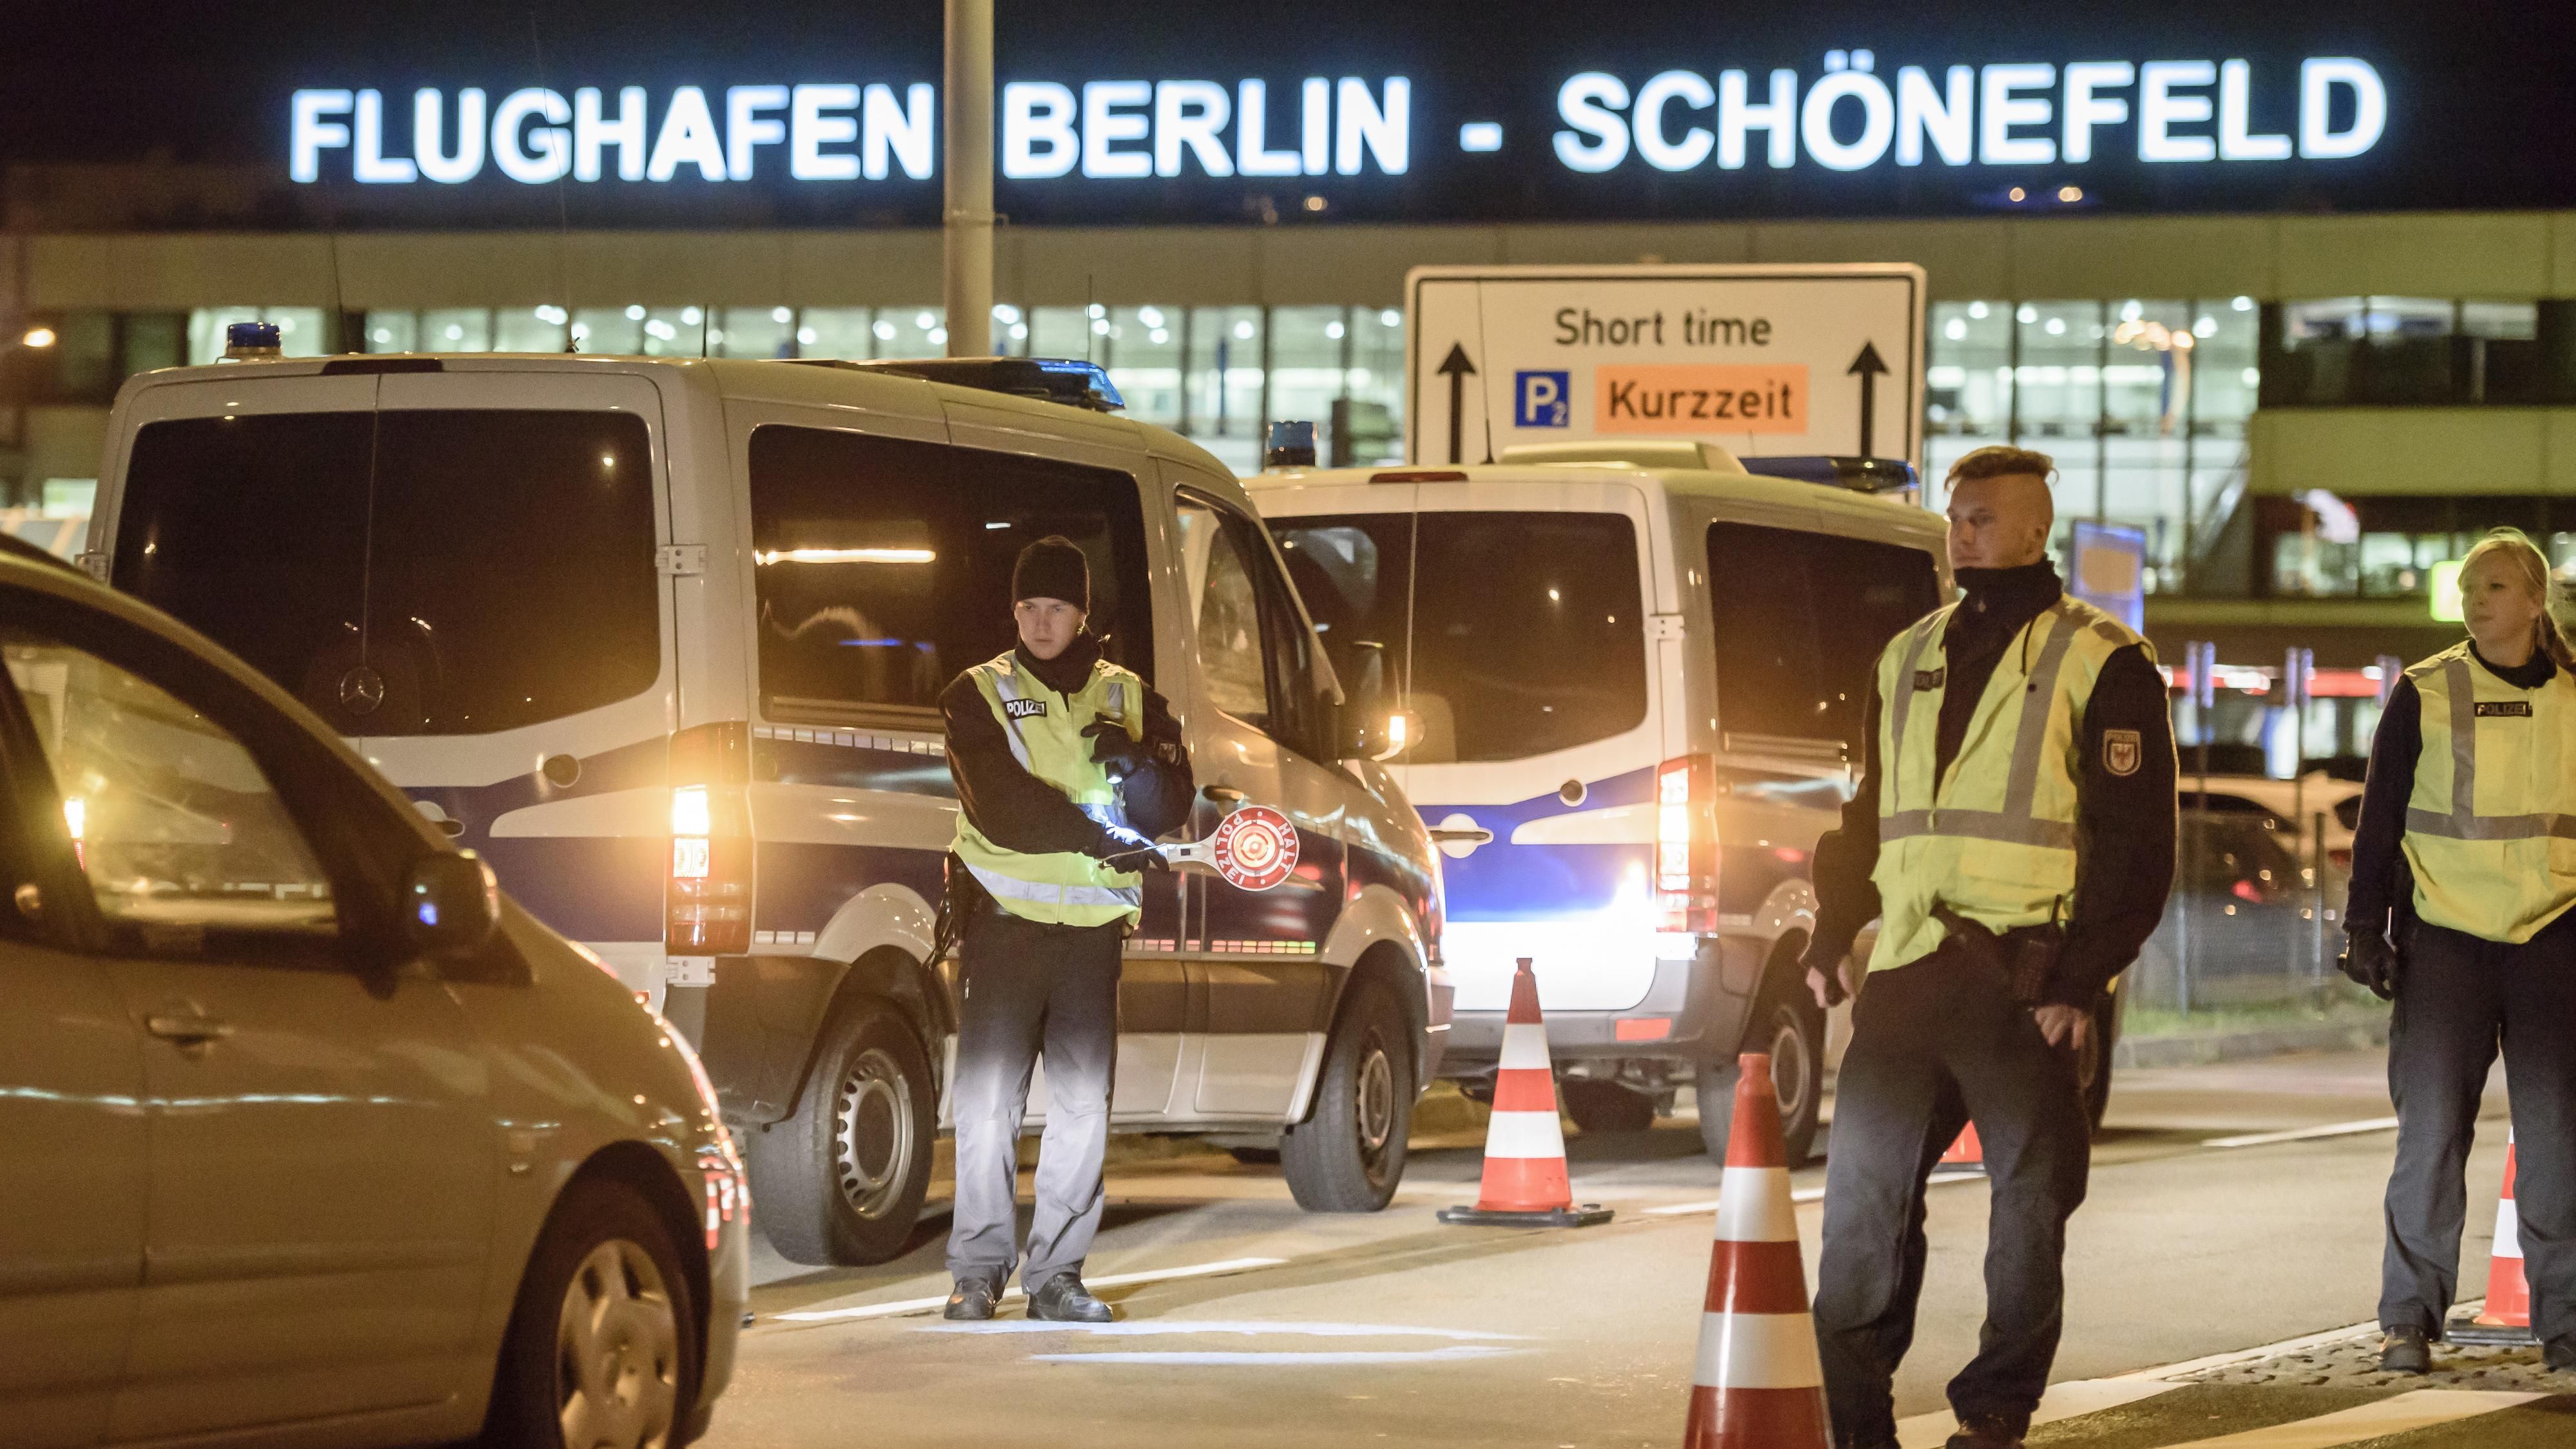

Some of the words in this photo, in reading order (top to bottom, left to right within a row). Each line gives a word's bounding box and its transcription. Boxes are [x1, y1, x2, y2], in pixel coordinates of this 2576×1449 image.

[290, 82, 935, 184] FLUGHAFEN
[1002, 76, 1411, 178] BERLIN
[1459, 122, 1502, 151] -
[1552, 49, 2387, 173] SCHÖNEFELD
[1554, 308, 1663, 346] Short
[1683, 308, 1773, 346] time
[1609, 381, 1793, 419] Kurzzeit
[1007, 699, 1045, 717] POLIZEI
[2477, 704, 2526, 715] POLIZEI
[1217, 813, 1244, 885] POLIZEI
[1278, 822, 1296, 873] HALT
